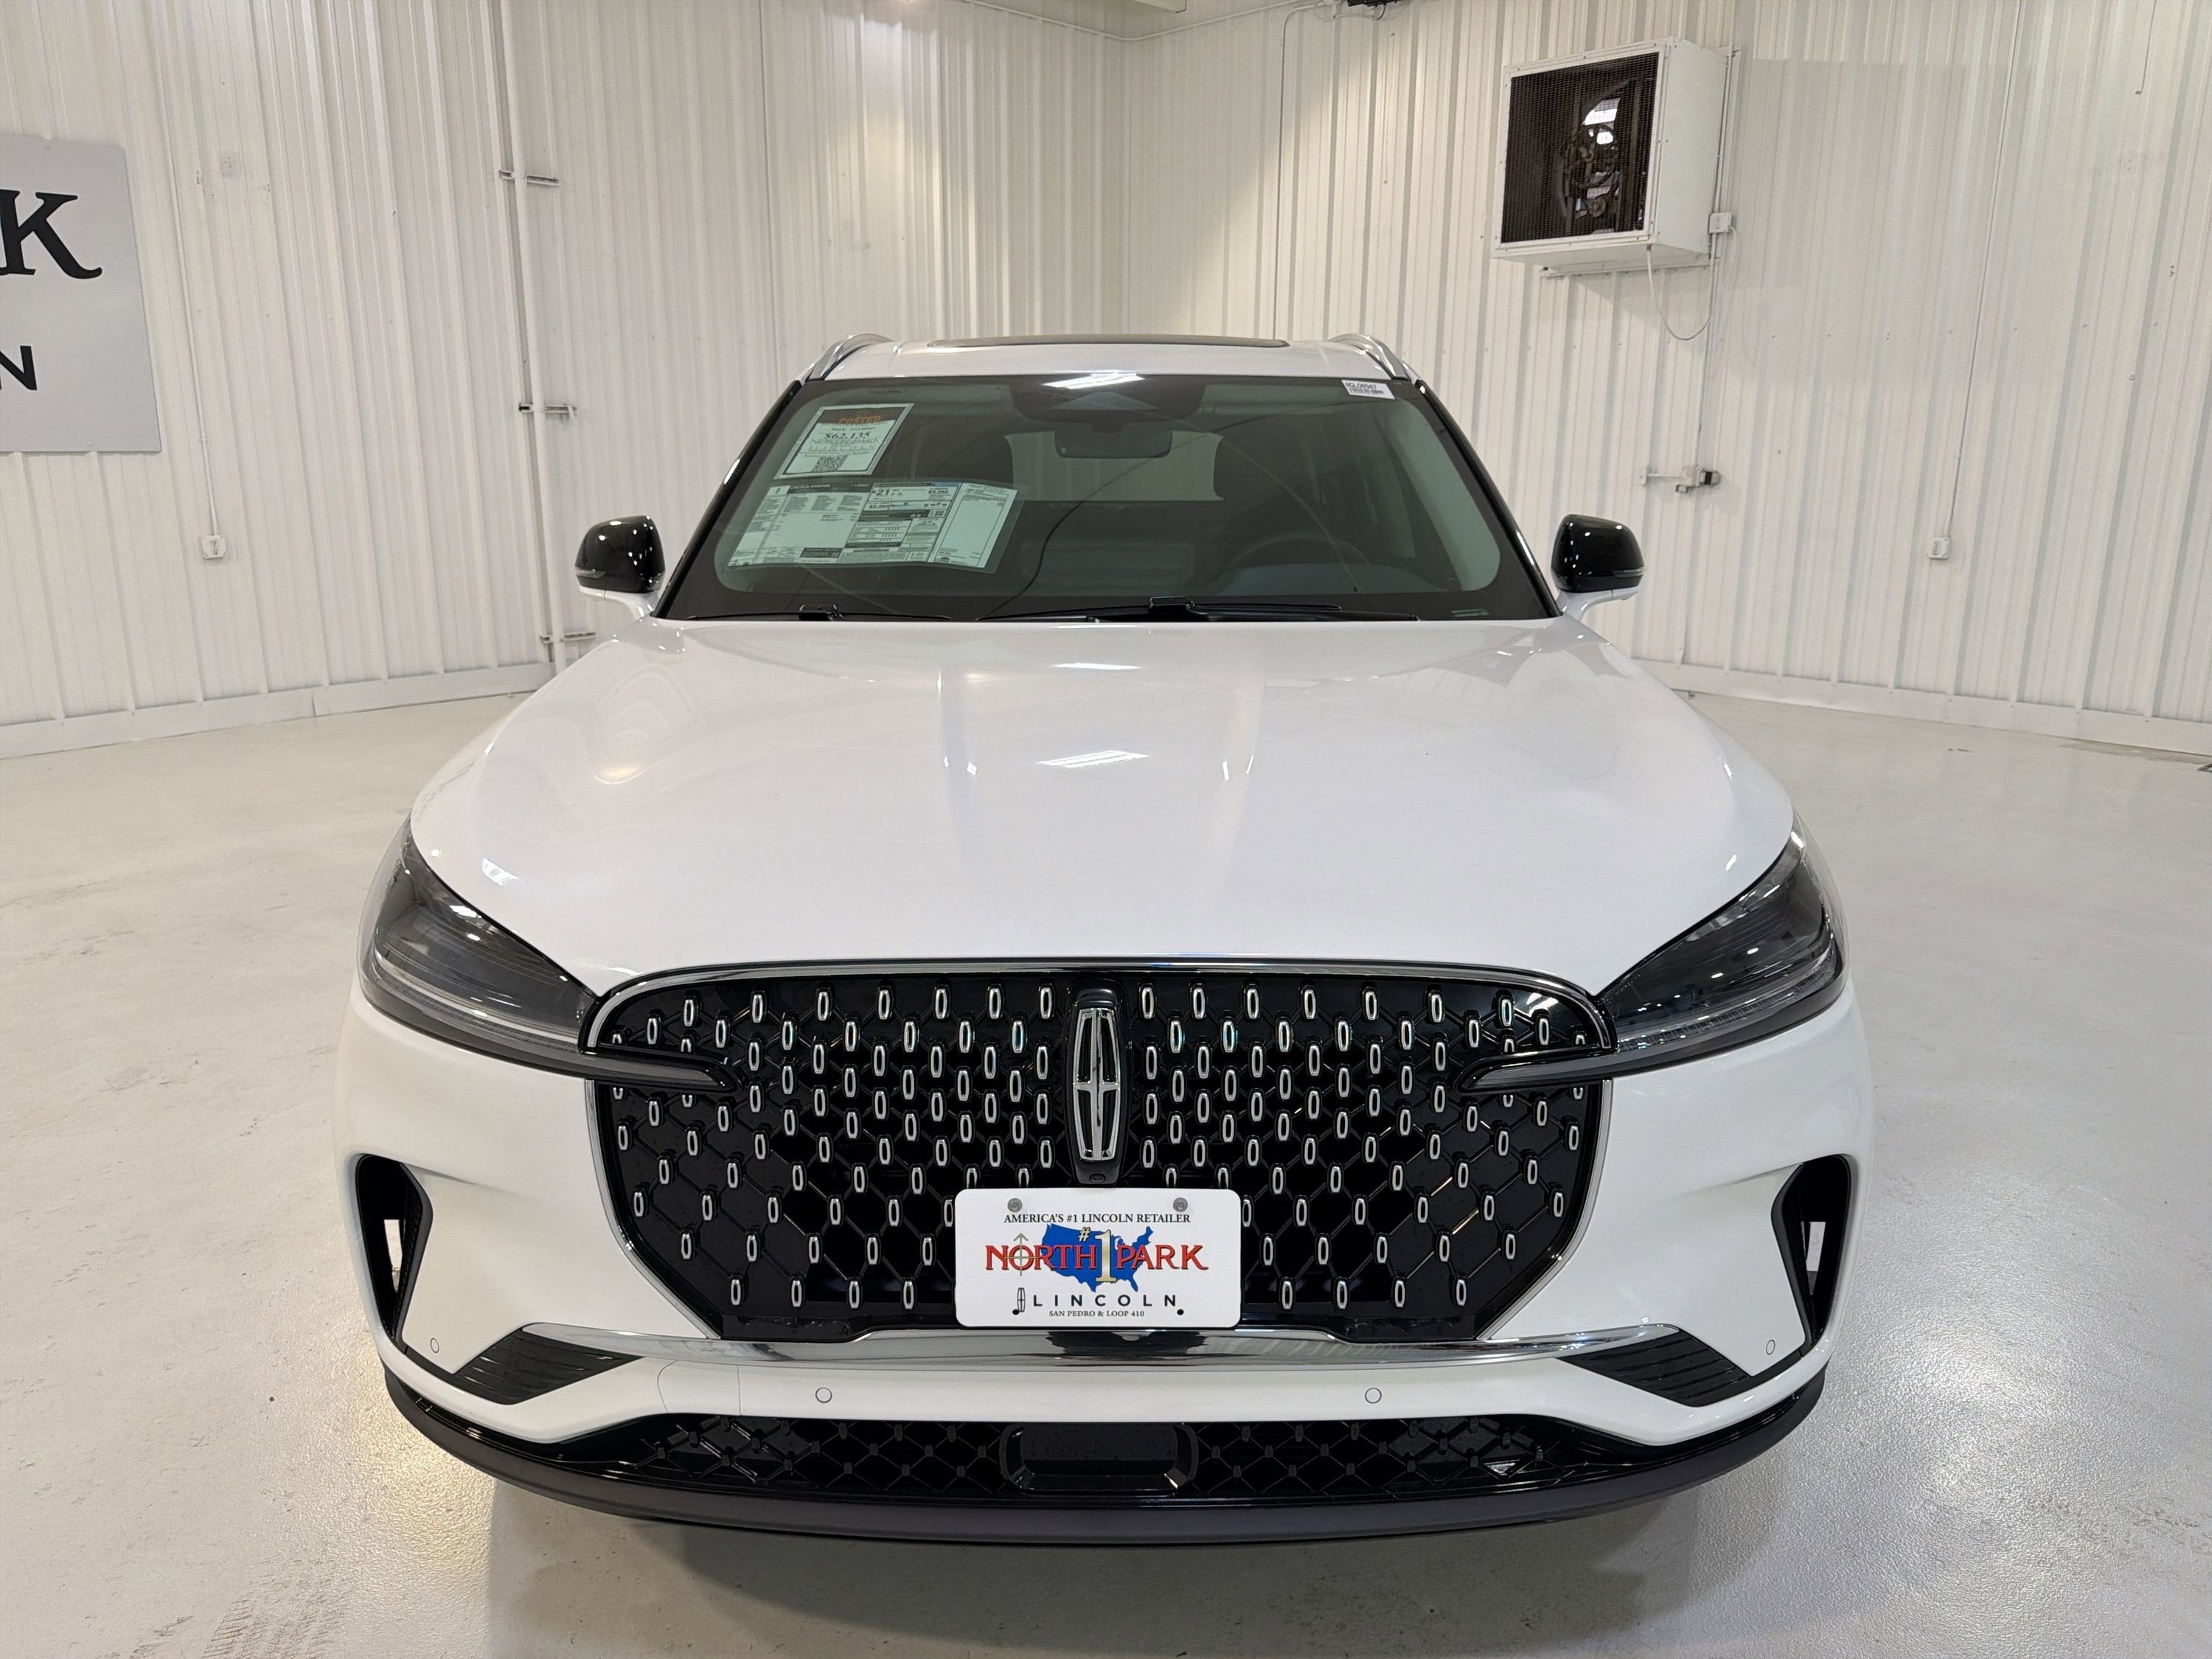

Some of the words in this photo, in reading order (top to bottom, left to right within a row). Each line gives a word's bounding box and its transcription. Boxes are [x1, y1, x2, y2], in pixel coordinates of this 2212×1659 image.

[0, 189, 102, 279] K
[1004, 1214, 1064, 1223] AMERICA'S
[1066, 1214, 1078, 1222] #1
[1082, 1214, 1133, 1223] LINCOLN
[1136, 1214, 1191, 1223] RETAILER
[985, 1245, 1097, 1271] NORTH
[1116, 1245, 1209, 1271] PARK
[1033, 1294, 1176, 1307] LINCOLN
